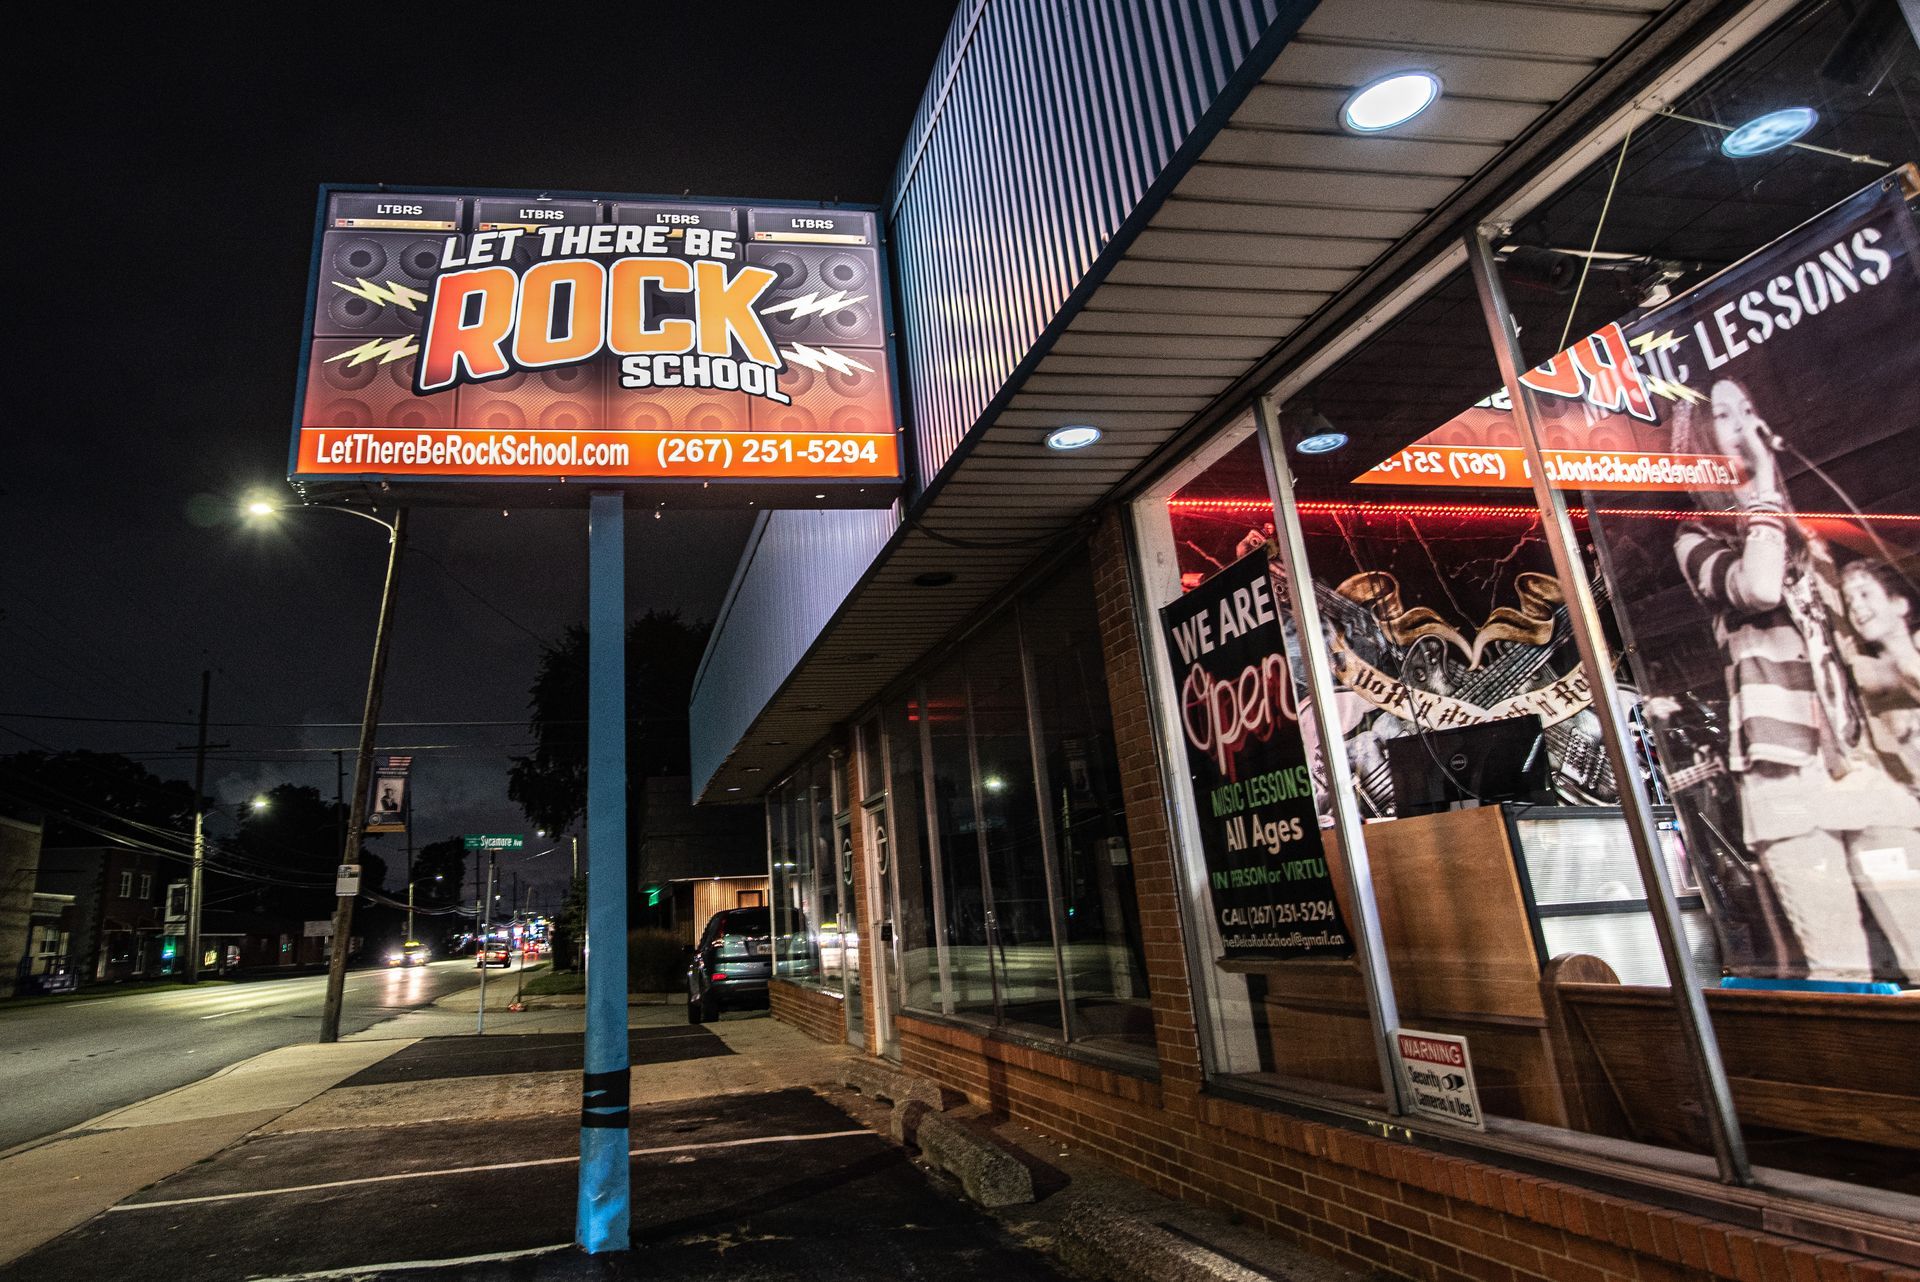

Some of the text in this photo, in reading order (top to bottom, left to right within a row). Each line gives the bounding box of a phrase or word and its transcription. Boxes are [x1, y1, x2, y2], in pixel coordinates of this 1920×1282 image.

[377, 203, 423, 216] LTBRS
[519, 208, 564, 221] LTBRS
[655, 213, 700, 226] LTBRS
[791, 217, 834, 231] LTBRS
[440, 224, 737, 269] LET THERE BE
[1694, 227, 1892, 371] LESSONS
[420, 257, 782, 390] ROCK
[622, 355, 790, 404] SCHOOL
[317, 433, 878, 468] LetThereBeRockSchool.com (267) 251-5294
[1172, 575, 1275, 665] WE ARE
[1181, 653, 1299, 777] Open
[1210, 764, 1313, 818] MUSIC LESSONS
[480, 835, 512, 848] Sycamore
[1225, 813, 1304, 855] All Ages
[1212, 871, 1229, 889] IN
[1231, 865, 1267, 888] PERSON
[1268, 869, 1281, 883] or
[1221, 908, 1248, 926] CALL
[1277, 900, 1335, 923] 251-5294
[1400, 1038, 1460, 1064] WARNING
[1408, 1065, 1442, 1092] Security
[1414, 1088, 1448, 1112] Cameras
[1456, 1097, 1473, 1118] Use
